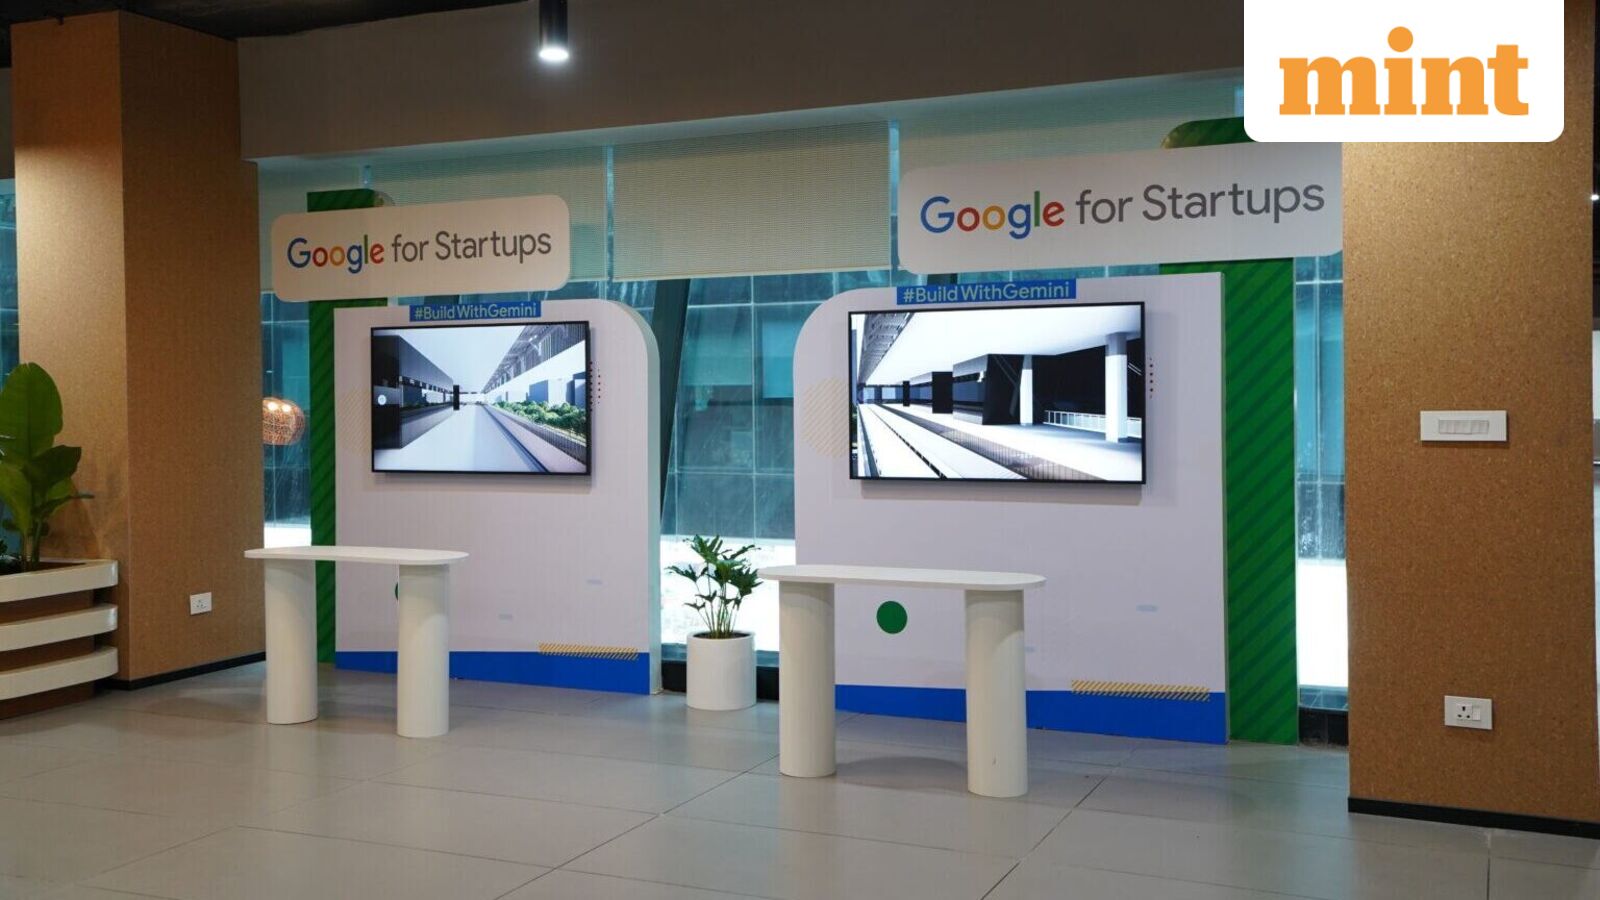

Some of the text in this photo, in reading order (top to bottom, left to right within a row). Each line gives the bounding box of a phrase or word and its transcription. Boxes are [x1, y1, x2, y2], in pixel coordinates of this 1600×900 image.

[920, 182, 1325, 240] Google for Startups
[287, 230, 552, 274] Google for Startups
